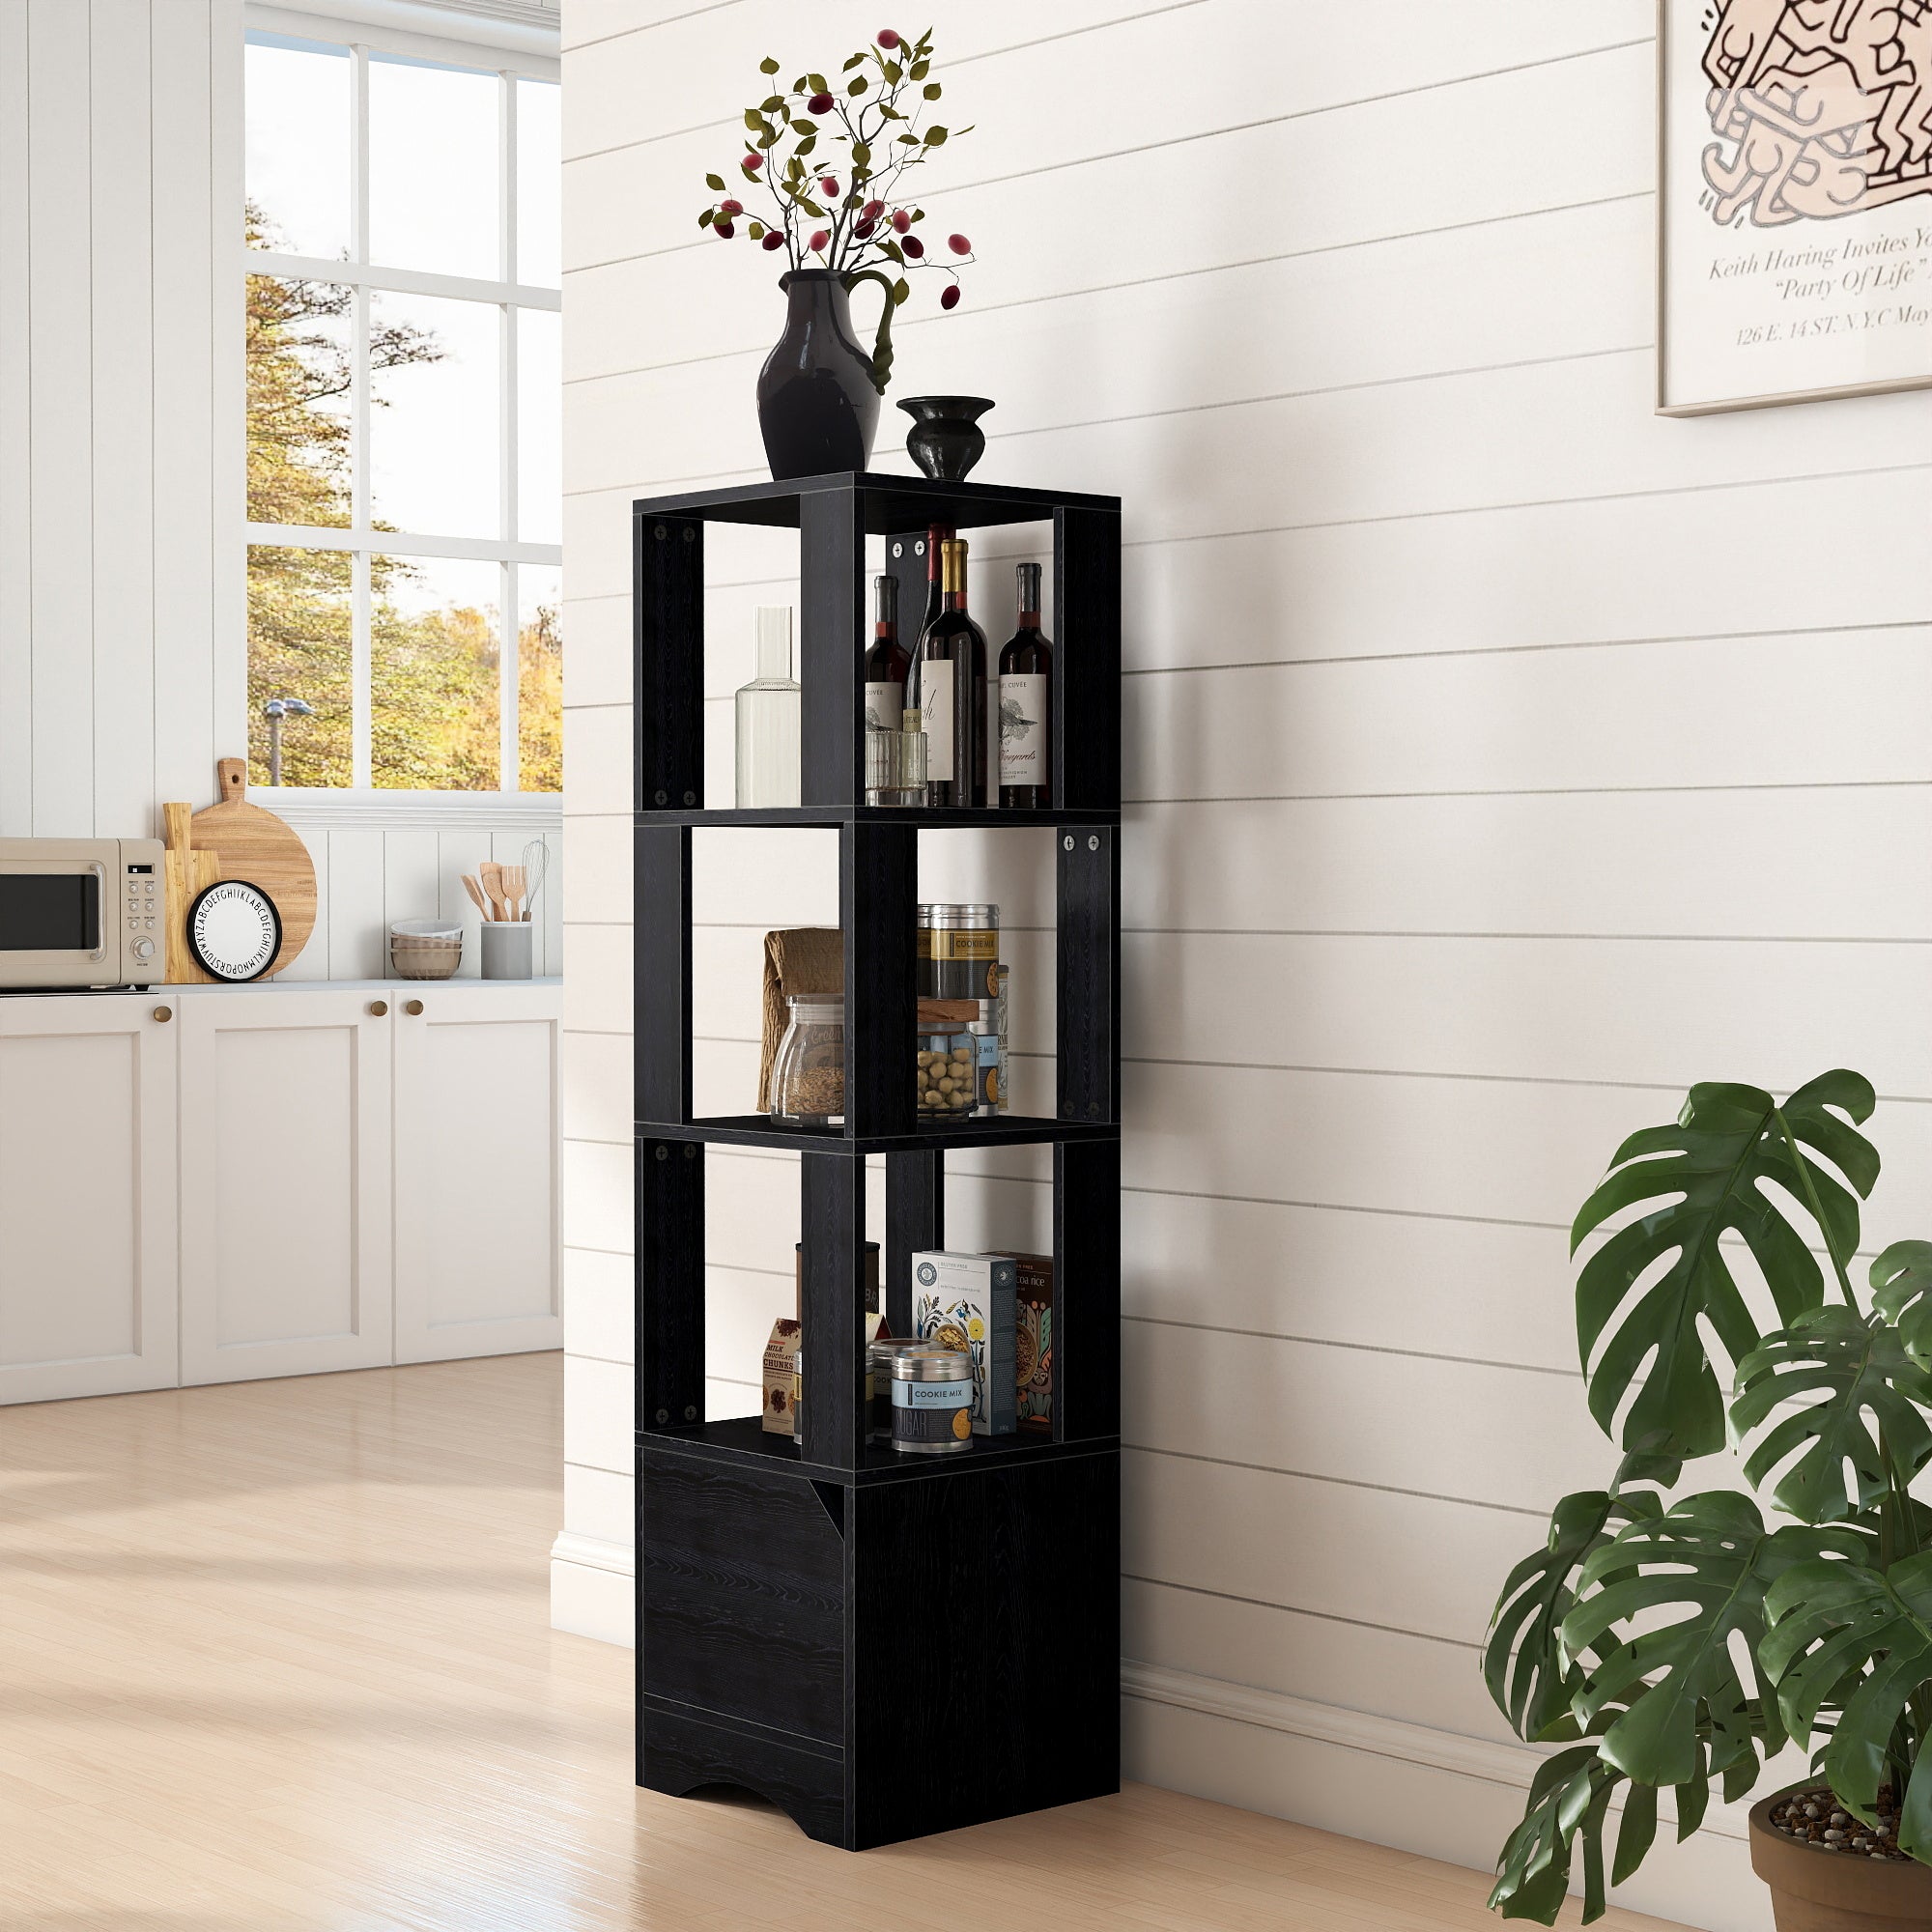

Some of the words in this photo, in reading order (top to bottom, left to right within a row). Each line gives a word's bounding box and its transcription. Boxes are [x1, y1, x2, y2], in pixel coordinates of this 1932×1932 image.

[1709, 253, 1758, 280] Keith
[1765, 244, 1837, 271] Haring
[1842, 234, 1909, 259] Invites
[1842, 267, 1874, 296] Of
[1737, 327, 1763, 346] 126
[1031, 1275, 1045, 1287] rice
[767, 1344, 783, 1352] MILK
[763, 1358, 794, 1370] CHUNKS
[949, 1389, 962, 1398] MIX
[895, 1409, 927, 1437] SUGAR
